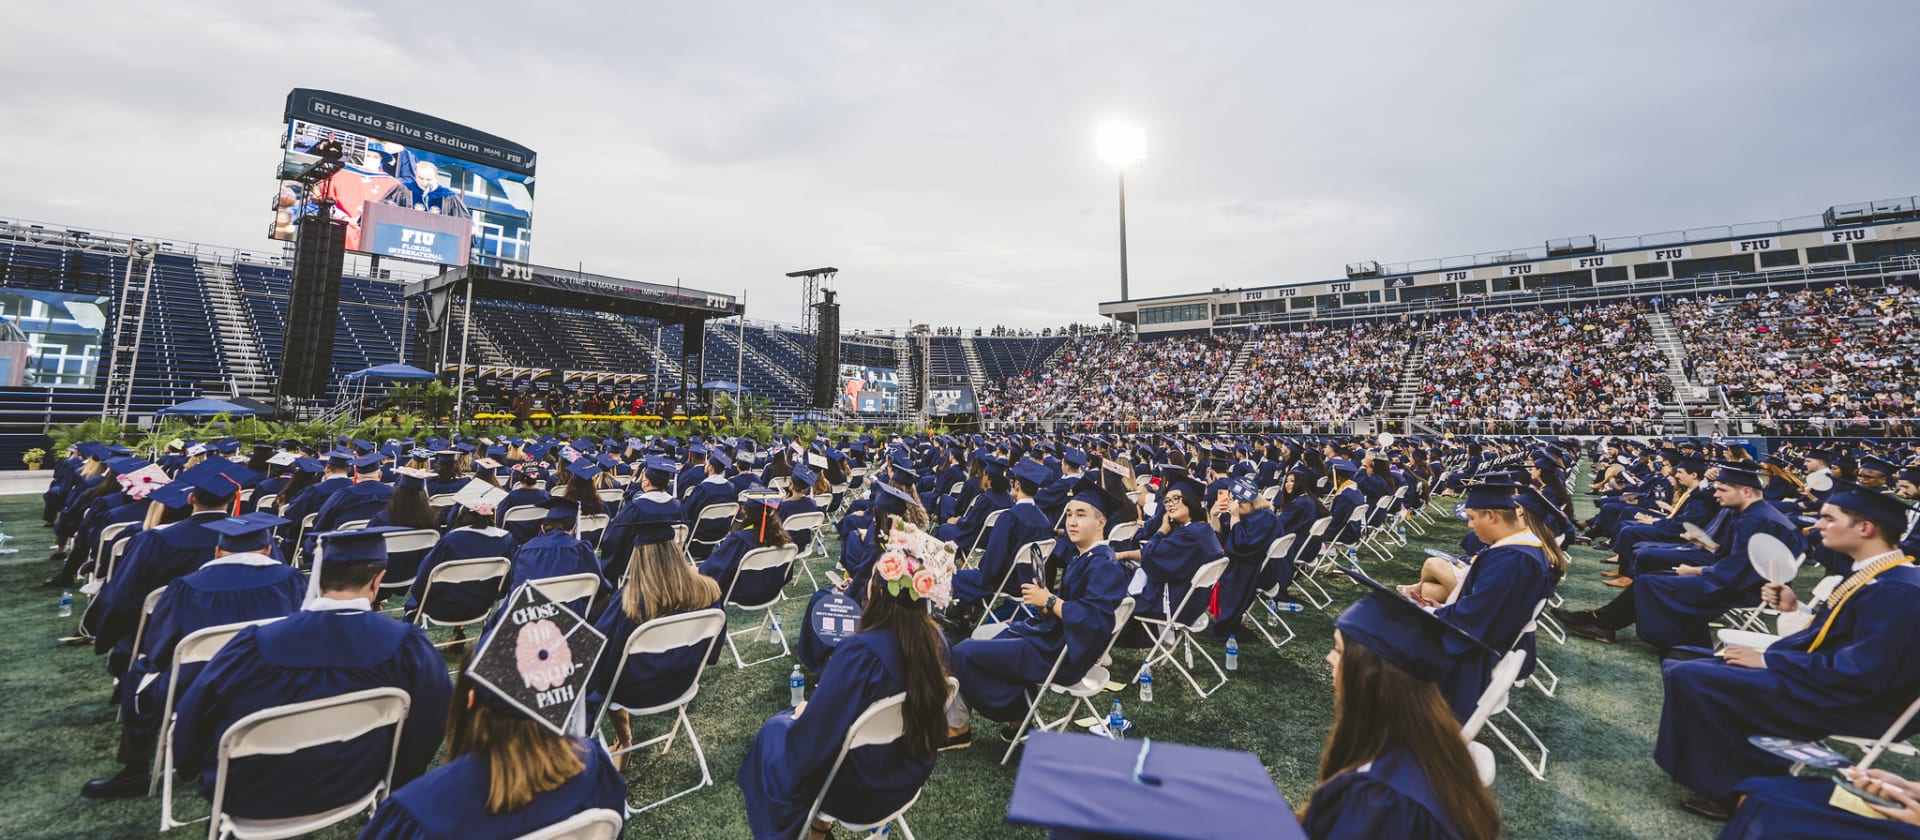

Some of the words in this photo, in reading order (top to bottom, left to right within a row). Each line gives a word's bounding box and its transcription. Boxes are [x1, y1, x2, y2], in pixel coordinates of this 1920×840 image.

[314, 102, 382, 128] Riccardo
[386, 121, 421, 139] Silva
[424, 131, 479, 153] Stadium
[507, 153, 521, 163] FIU
[401, 228, 436, 246] FIU
[1832, 229, 1865, 243] FIU
[402, 243, 432, 252] FLORIDA
[1740, 239, 1770, 252] FIU
[388, 247, 444, 260] INTERNATIONAL
[1655, 248, 1683, 261] FIU
[1579, 257, 1605, 269] FIU
[501, 262, 534, 281] FIU
[1446, 271, 1468, 282] FIU
[1509, 264, 1532, 276] FIU
[1279, 288, 1296, 298] FIU
[1331, 282, 1352, 293] FIU
[706, 294, 729, 309] FIU
[1245, 291, 1262, 301] FIU
[525, 586, 535, 603] I
[512, 603, 560, 625] CHOSE
[536, 685, 574, 709] PATH
